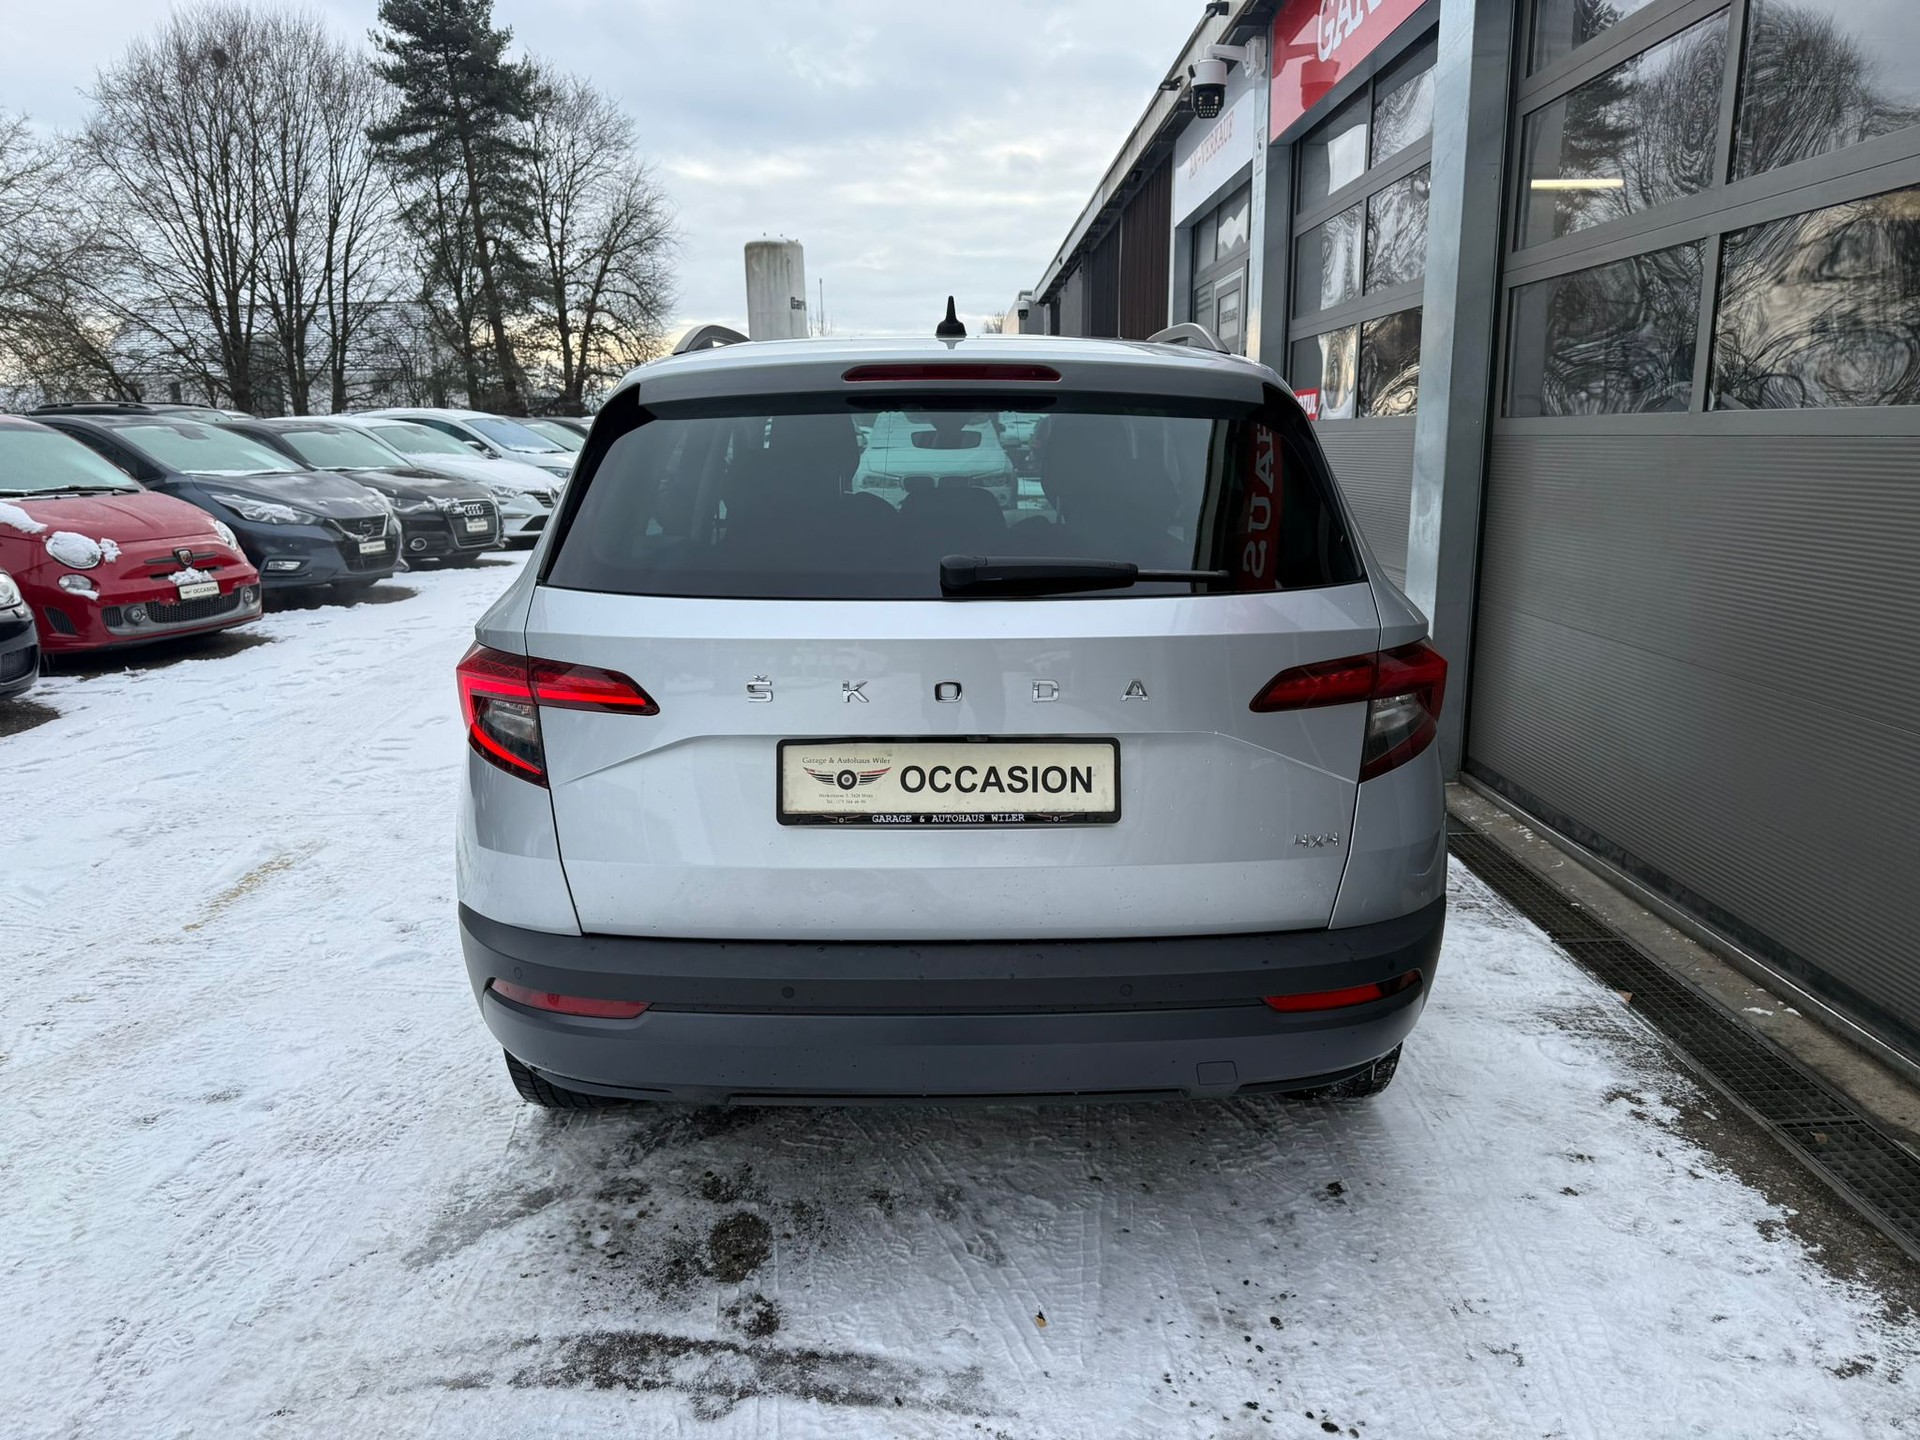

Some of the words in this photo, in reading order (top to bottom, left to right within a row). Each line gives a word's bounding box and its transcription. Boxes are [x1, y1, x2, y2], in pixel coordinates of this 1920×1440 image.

[1297, 393, 1317, 416] OTUL
[193, 586, 218, 594] OCCASION
[746, 674, 1150, 704] ŠKODA
[802, 757, 827, 766] Garage
[900, 765, 1093, 794] OCCASION
[872, 814, 912, 823] GARAGE
[919, 815, 925, 823] &
[931, 814, 985, 823] AUTOHAUS
[991, 813, 1025, 822] WILER
